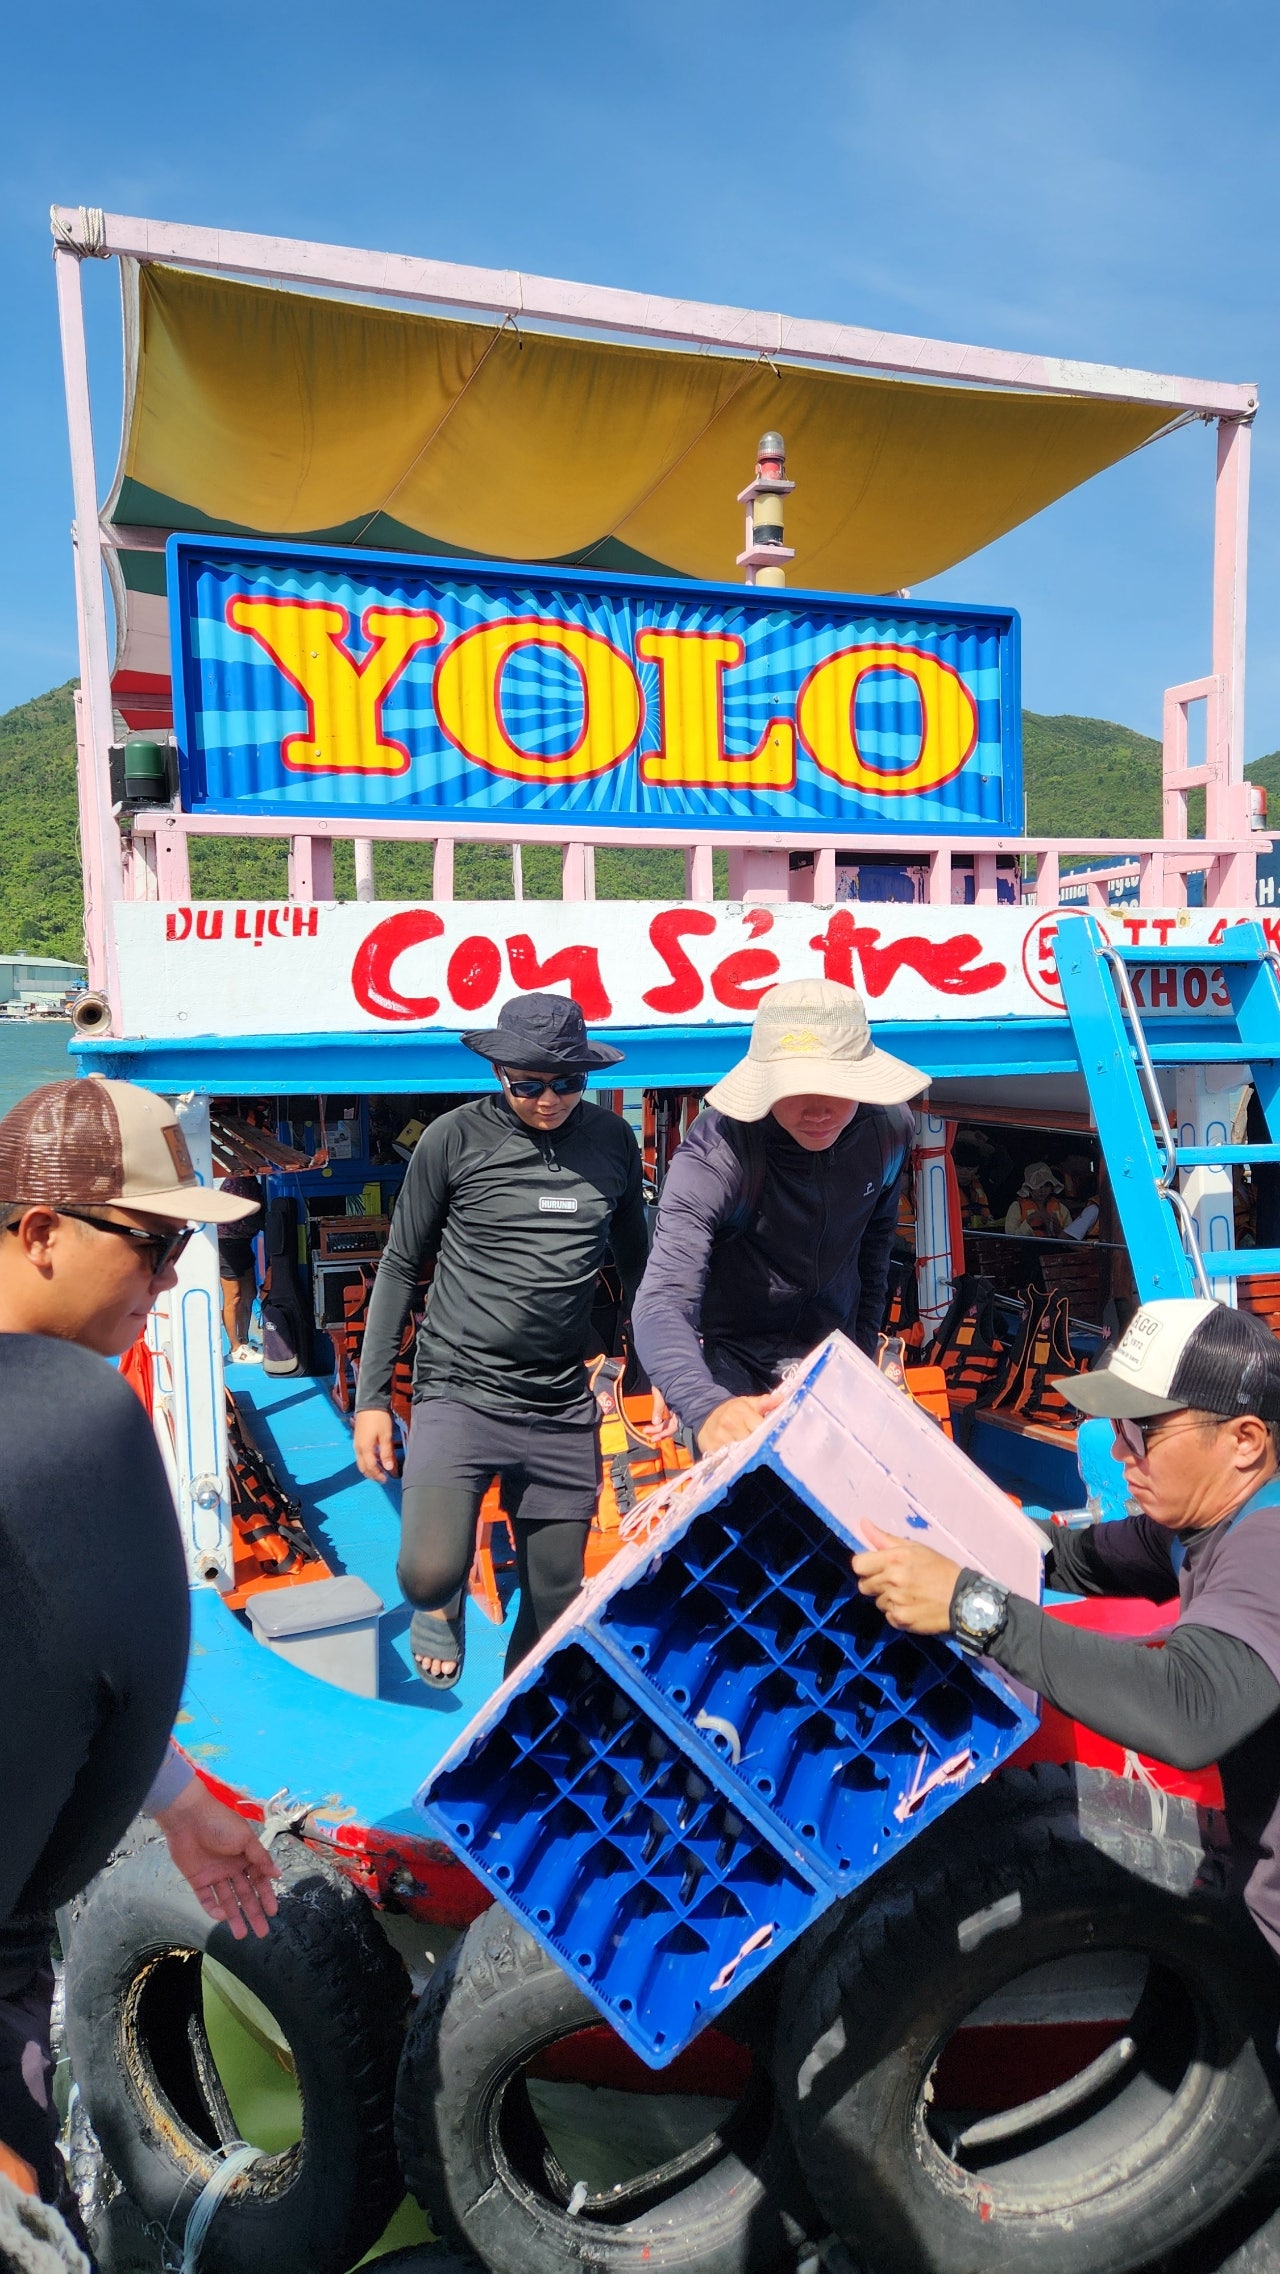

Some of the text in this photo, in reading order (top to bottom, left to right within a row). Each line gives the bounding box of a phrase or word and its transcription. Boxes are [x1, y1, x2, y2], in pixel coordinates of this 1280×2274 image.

[225, 592, 979, 798] YOLO
[166, 906, 319, 948] DU LỊCH
[351, 908, 613, 1022] Con
[1120, 967, 1232, 1009] KH03
[1132, 1314, 1159, 1336] AGO
